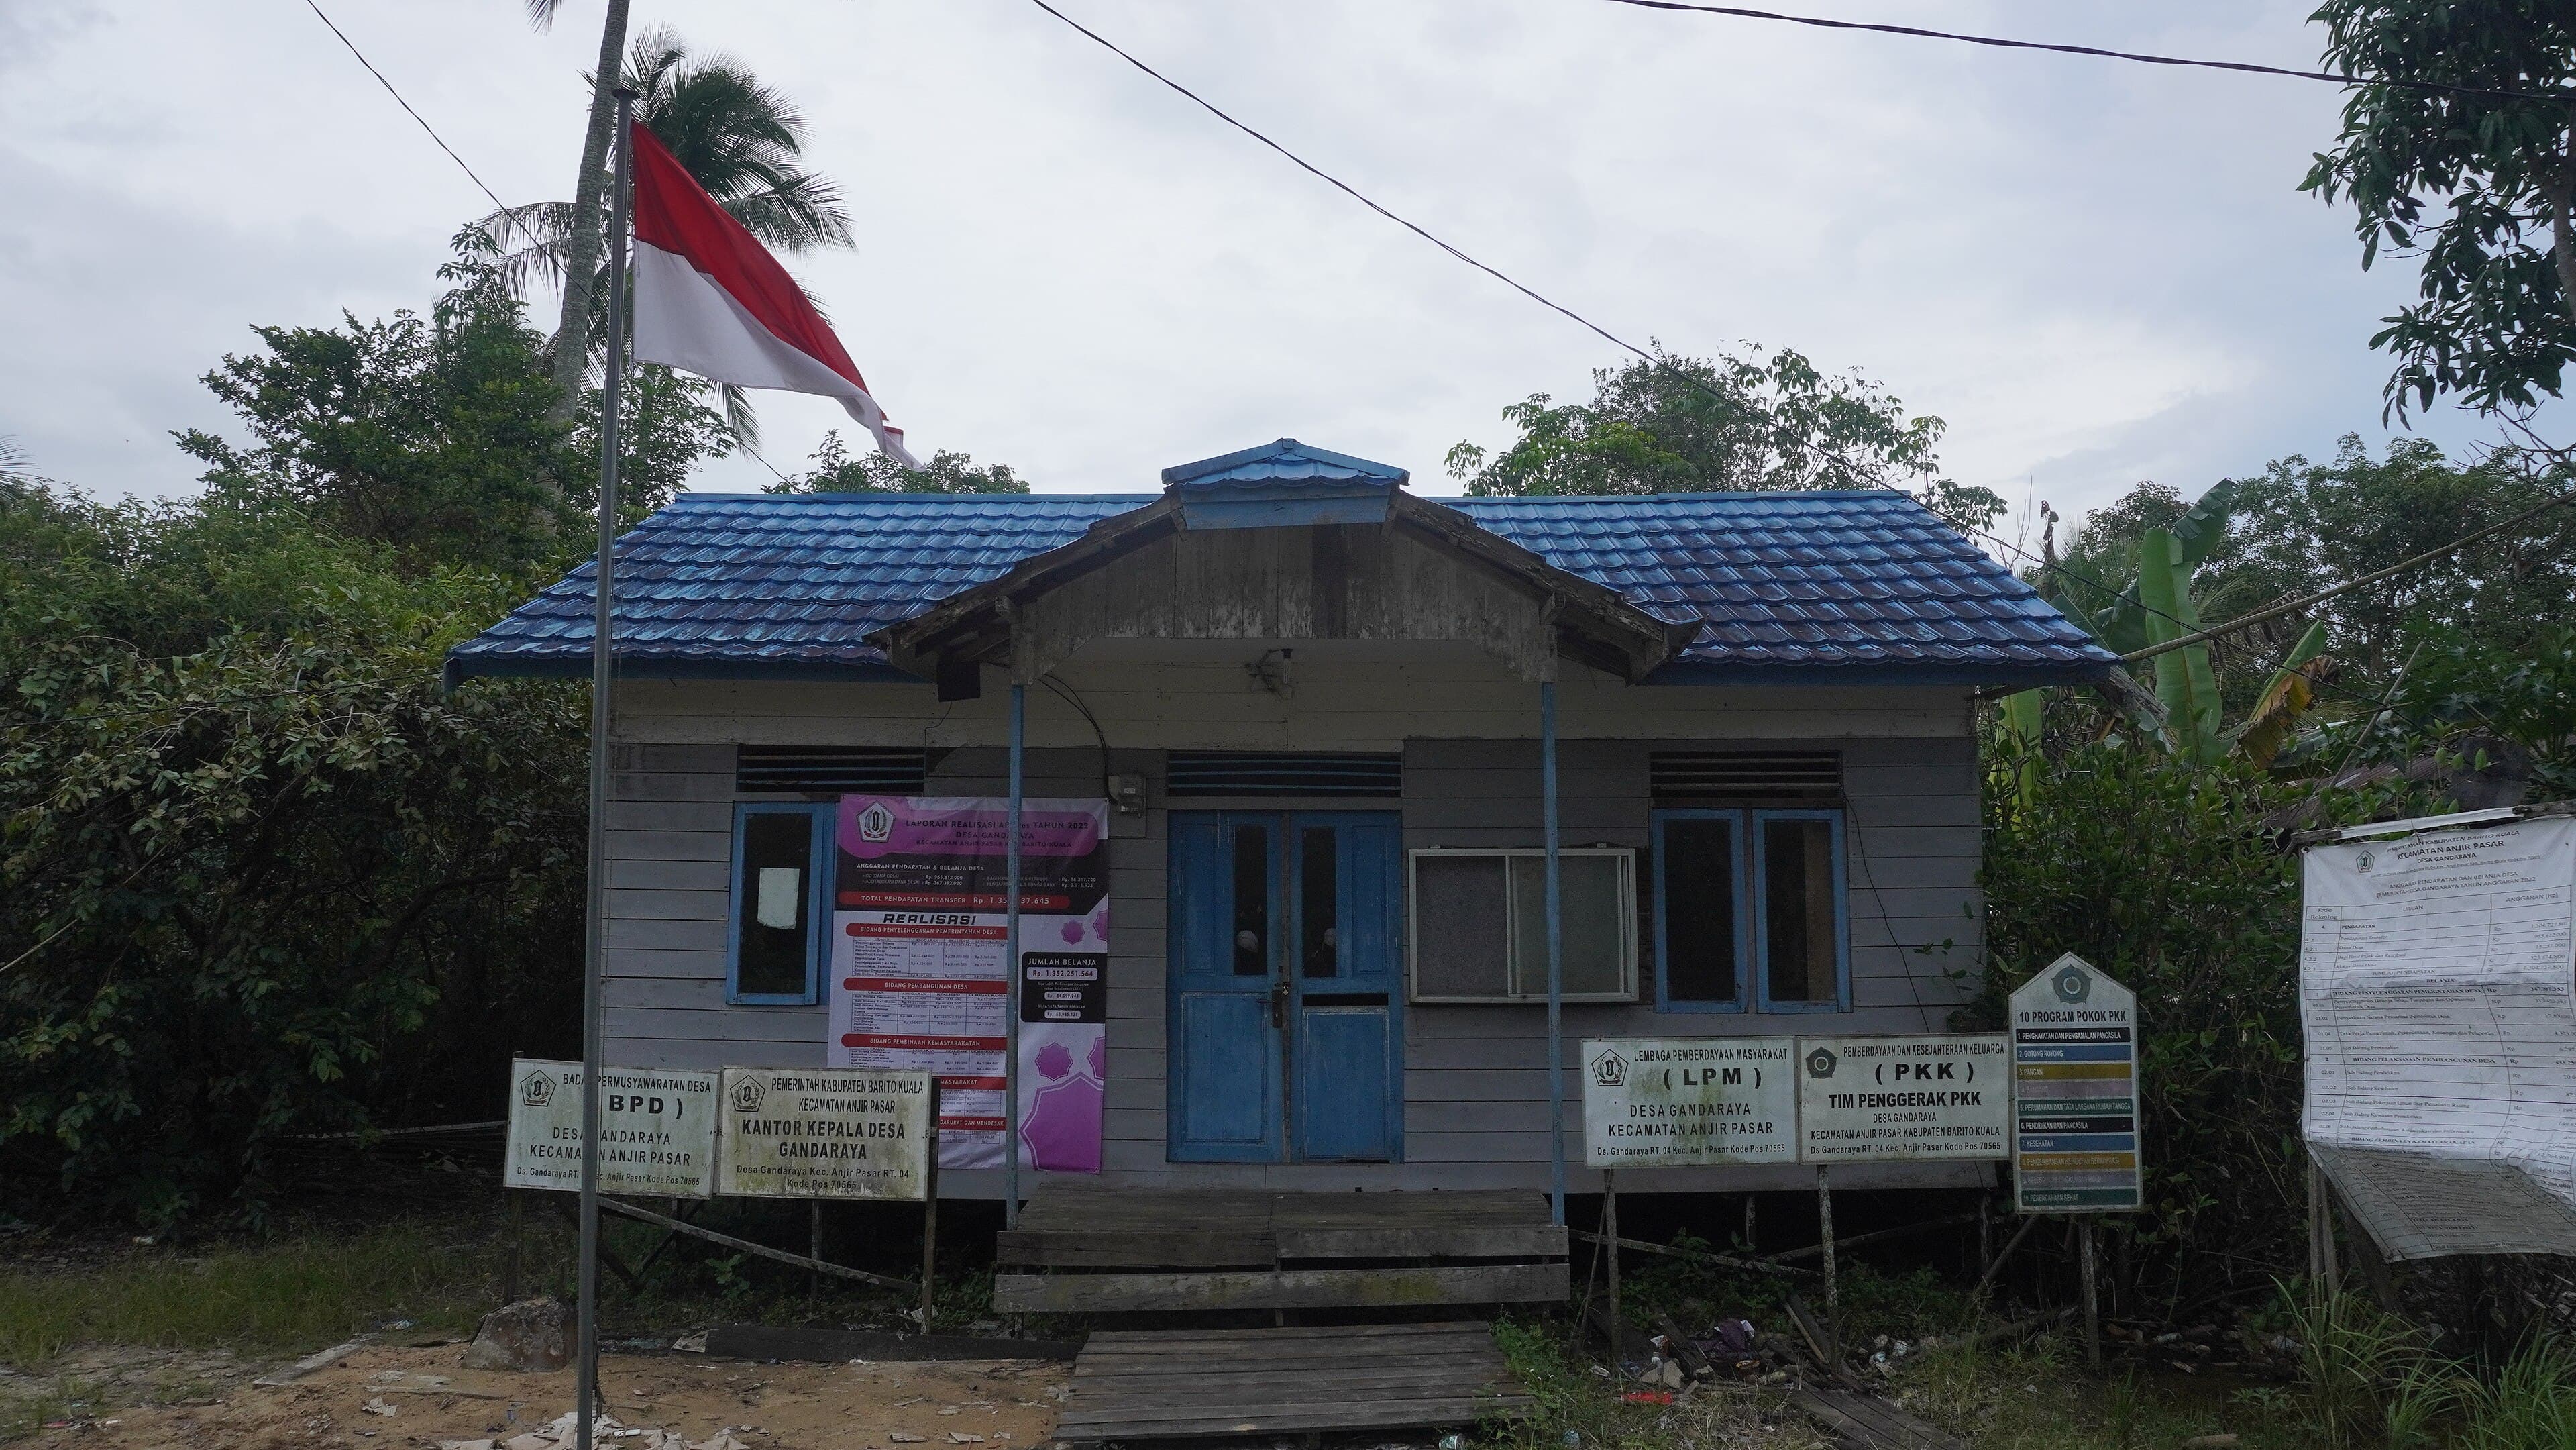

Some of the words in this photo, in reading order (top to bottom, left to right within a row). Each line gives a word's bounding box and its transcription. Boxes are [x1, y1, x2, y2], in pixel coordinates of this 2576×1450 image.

[951, 820, 996, 829] REALISASI
[2425, 837, 2465, 846] KABUPATEN
[2397, 847, 2443, 860] KECAMATAN
[2434, 853, 2477, 862] GANDARAYA
[2506, 894, 2544, 902] ANGGARAN
[883, 914, 977, 925] REALISASI
[2020, 1011, 2029, 1023] 10
[2033, 1011, 2074, 1023] PROGRAM
[2077, 1011, 2106, 1022] POKOK
[2109, 1011, 2127, 1021] PKK
[2096, 1031, 2121, 1039] PANCASILA
[1634, 1049, 1671, 1062] LEMBAGA
[1673, 1049, 1734, 1061] PEMBERDAYAAN
[1736, 1048, 1788, 1060] MASYARAKAT
[1843, 1045, 1896, 1057] PEMBERDAYAAN
[1898, 1045, 1911, 1057] DAN
[1913, 1044, 1968, 1057] KESEJAHTERAAN
[1969, 1043, 2004, 1055] KELUARGA
[1684, 1068, 1741, 1086] LPM
[1895, 1063, 1955, 1081] PKK
[688, 1081, 711, 1092] DESA
[771, 1078, 820, 1092] PEMERINTAH
[822, 1080, 866, 1093] KABUPATEN
[869, 1080, 897, 1094] BARITO
[898, 1081, 924, 1094] KUALA
[609, 1094, 664, 1114] BPD
[799, 1098, 845, 1112] KECAMATAN
[847, 1099, 868, 1113] ANJIR
[870, 1100, 895, 1114] PASAR
[1829, 1094, 1854, 1109] TIM
[1858, 1092, 1947, 1108] PENGGERAK
[1951, 1091, 1982, 1106] PKK
[1630, 1104, 1665, 1117] DESA
[1670, 1103, 1752, 1116] GANDARAYA
[1873, 1112, 1892, 1123] DESA
[1894, 1112, 1937, 1123] GANDARAYA
[742, 1119, 802, 1135] KANTOR
[807, 1121, 863, 1137] KEPALA
[868, 1123, 905, 1139] DESA
[1609, 1123, 1685, 1137] KECAMATAN
[1690, 1122, 1727, 1135] ANJIR
[1732, 1121, 1773, 1135] PASAR
[2026, 1122, 2053, 1130] PENDIDIKAN
[2063, 1121, 2088, 1129] PANCASILA
[600, 1130, 671, 1145] ANDARAYA
[1811, 1129, 1854, 1140] KECAMATAN
[1856, 1129, 1877, 1139] ANJIR
[1879, 1128, 1902, 1138] PASAR
[1904, 1127, 1945, 1137] KABUPATEN
[1947, 1127, 1974, 1137] BARITO
[1976, 1126, 2000, 1136] KUALA
[530, 1145, 606, 1161] KECAMAN
[610, 1149, 646, 1163] ANJIR
[651, 1153, 690, 1166] PASAR
[779, 1141, 867, 1159] GANDARAYA
[1597, 1147, 1609, 1155] Ds.
[1611, 1147, 1649, 1157] Gandaraya
[1650, 1147, 1662, 1155] RT.
[1663, 1147, 1671, 1155] 04
[1673, 1145, 1688, 1154] Kec.
[1690, 1145, 1707, 1155] Anjir
[1709, 1145, 1729, 1154] Pasar
[1731, 1145, 1748, 1154] Kode
[1750, 1144, 1763, 1153] Pos
[1765, 1144, 1785, 1152] 70565
[1821, 1145, 1860, 1155] Gandaraya
[1862, 1145, 1874, 1153] RT.
[1875, 1145, 1883, 1153] 04
[1903, 1144, 1921, 1154] Anjir
[1922, 1143, 1943, 1151] Pasar
[1944, 1143, 1963, 1151] Kode
[1965, 1143, 1978, 1151] Pos
[1980, 1142, 2001, 1150] 70565
[517, 1167, 528, 1175] Ds.
[530, 1168, 567, 1179] Gandaraya
[607, 1172, 624, 1182] Anjir
[626, 1174, 645, 1182] Pasar
[647, 1174, 664, 1183] Kode
[665, 1176, 678, 1184] Pos
[680, 1177, 700, 1185] 70565
[737, 1165, 758, 1174] Desa
[760, 1166, 807, 1176] Gandaraya
[810, 1168, 828, 1176] Kec.
[832, 1168, 853, 1178] Anjir
[856, 1169, 880, 1178] Pasar
[883, 1170, 896, 1178] RT.
[788, 1179, 810, 1188] Kode
[812, 1180, 828, 1188] Pos
[831, 1180, 857, 1189] 70565
